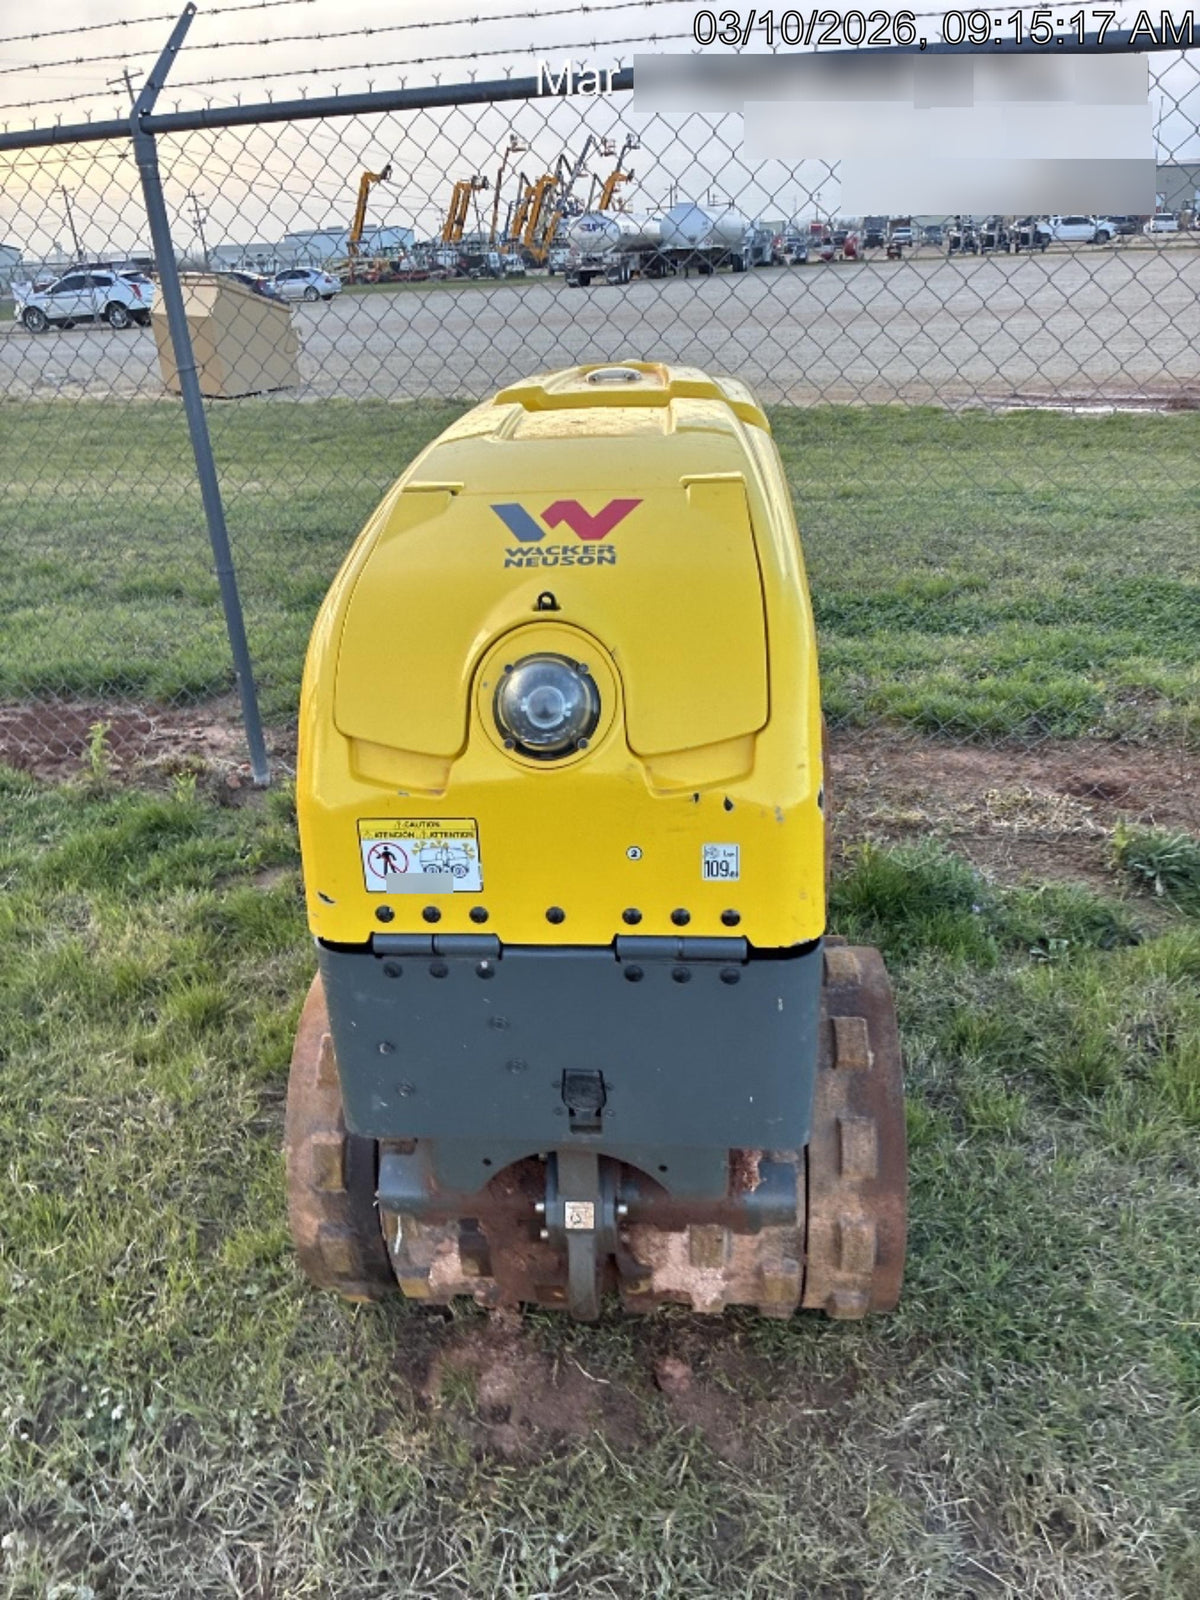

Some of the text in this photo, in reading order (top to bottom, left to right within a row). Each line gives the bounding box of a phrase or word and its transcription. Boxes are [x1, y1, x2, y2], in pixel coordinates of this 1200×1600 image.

[504, 545, 615, 558] WACKER
[504, 555, 616, 568] NEUSON
[704, 860, 730, 877] 109
